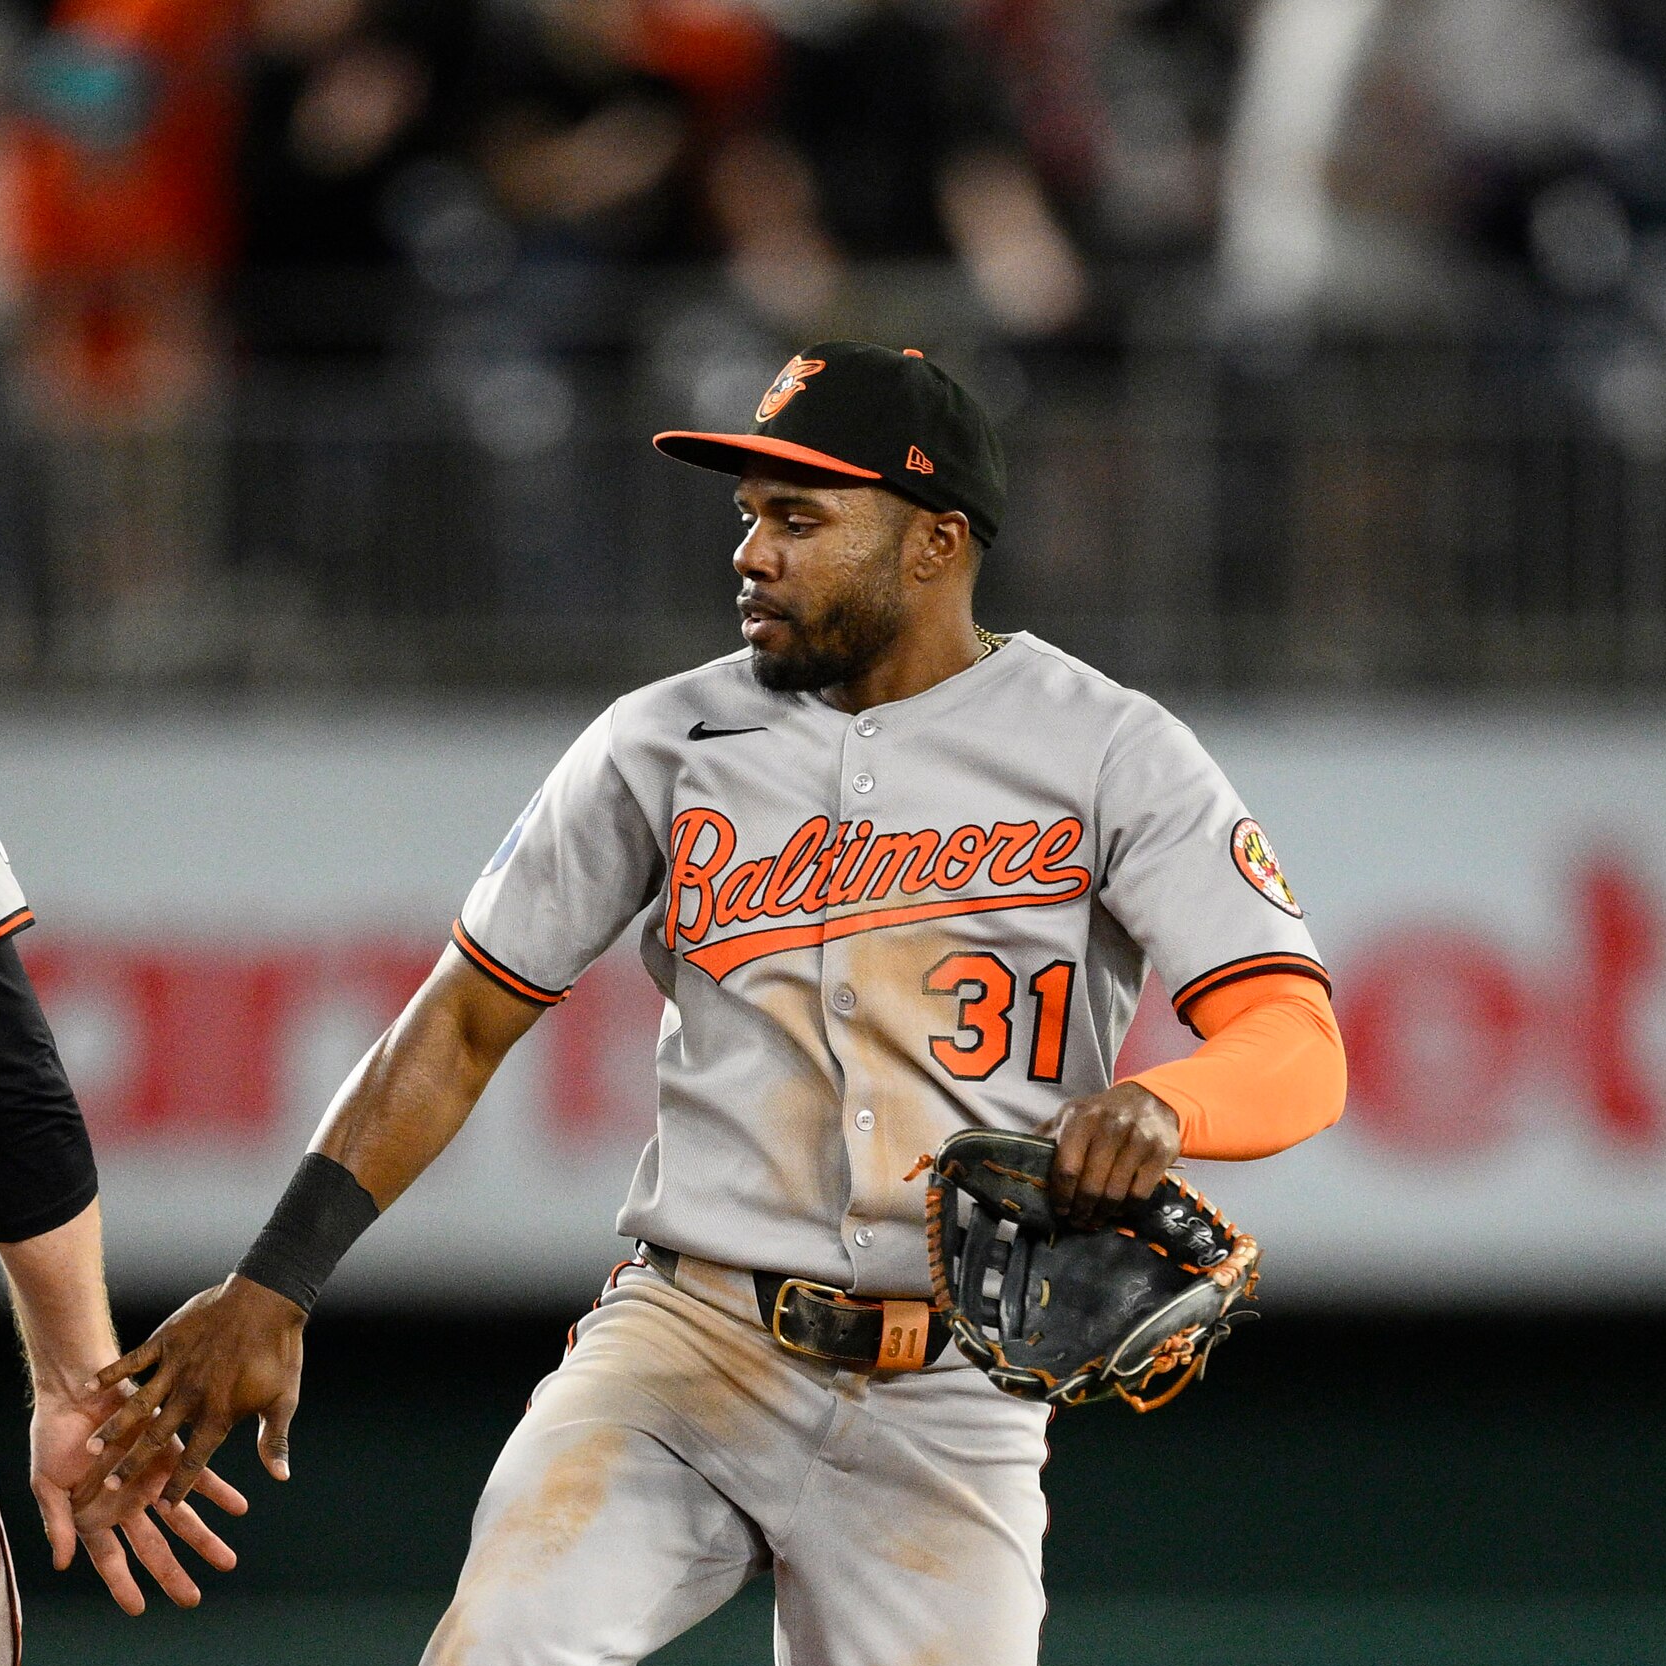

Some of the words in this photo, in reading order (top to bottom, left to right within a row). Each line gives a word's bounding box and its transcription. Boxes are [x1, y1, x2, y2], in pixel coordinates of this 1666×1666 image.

[665, 807, 1091, 951] Baltimore
[922, 951, 1076, 1084] 31
[887, 1326, 919, 1359] 31
